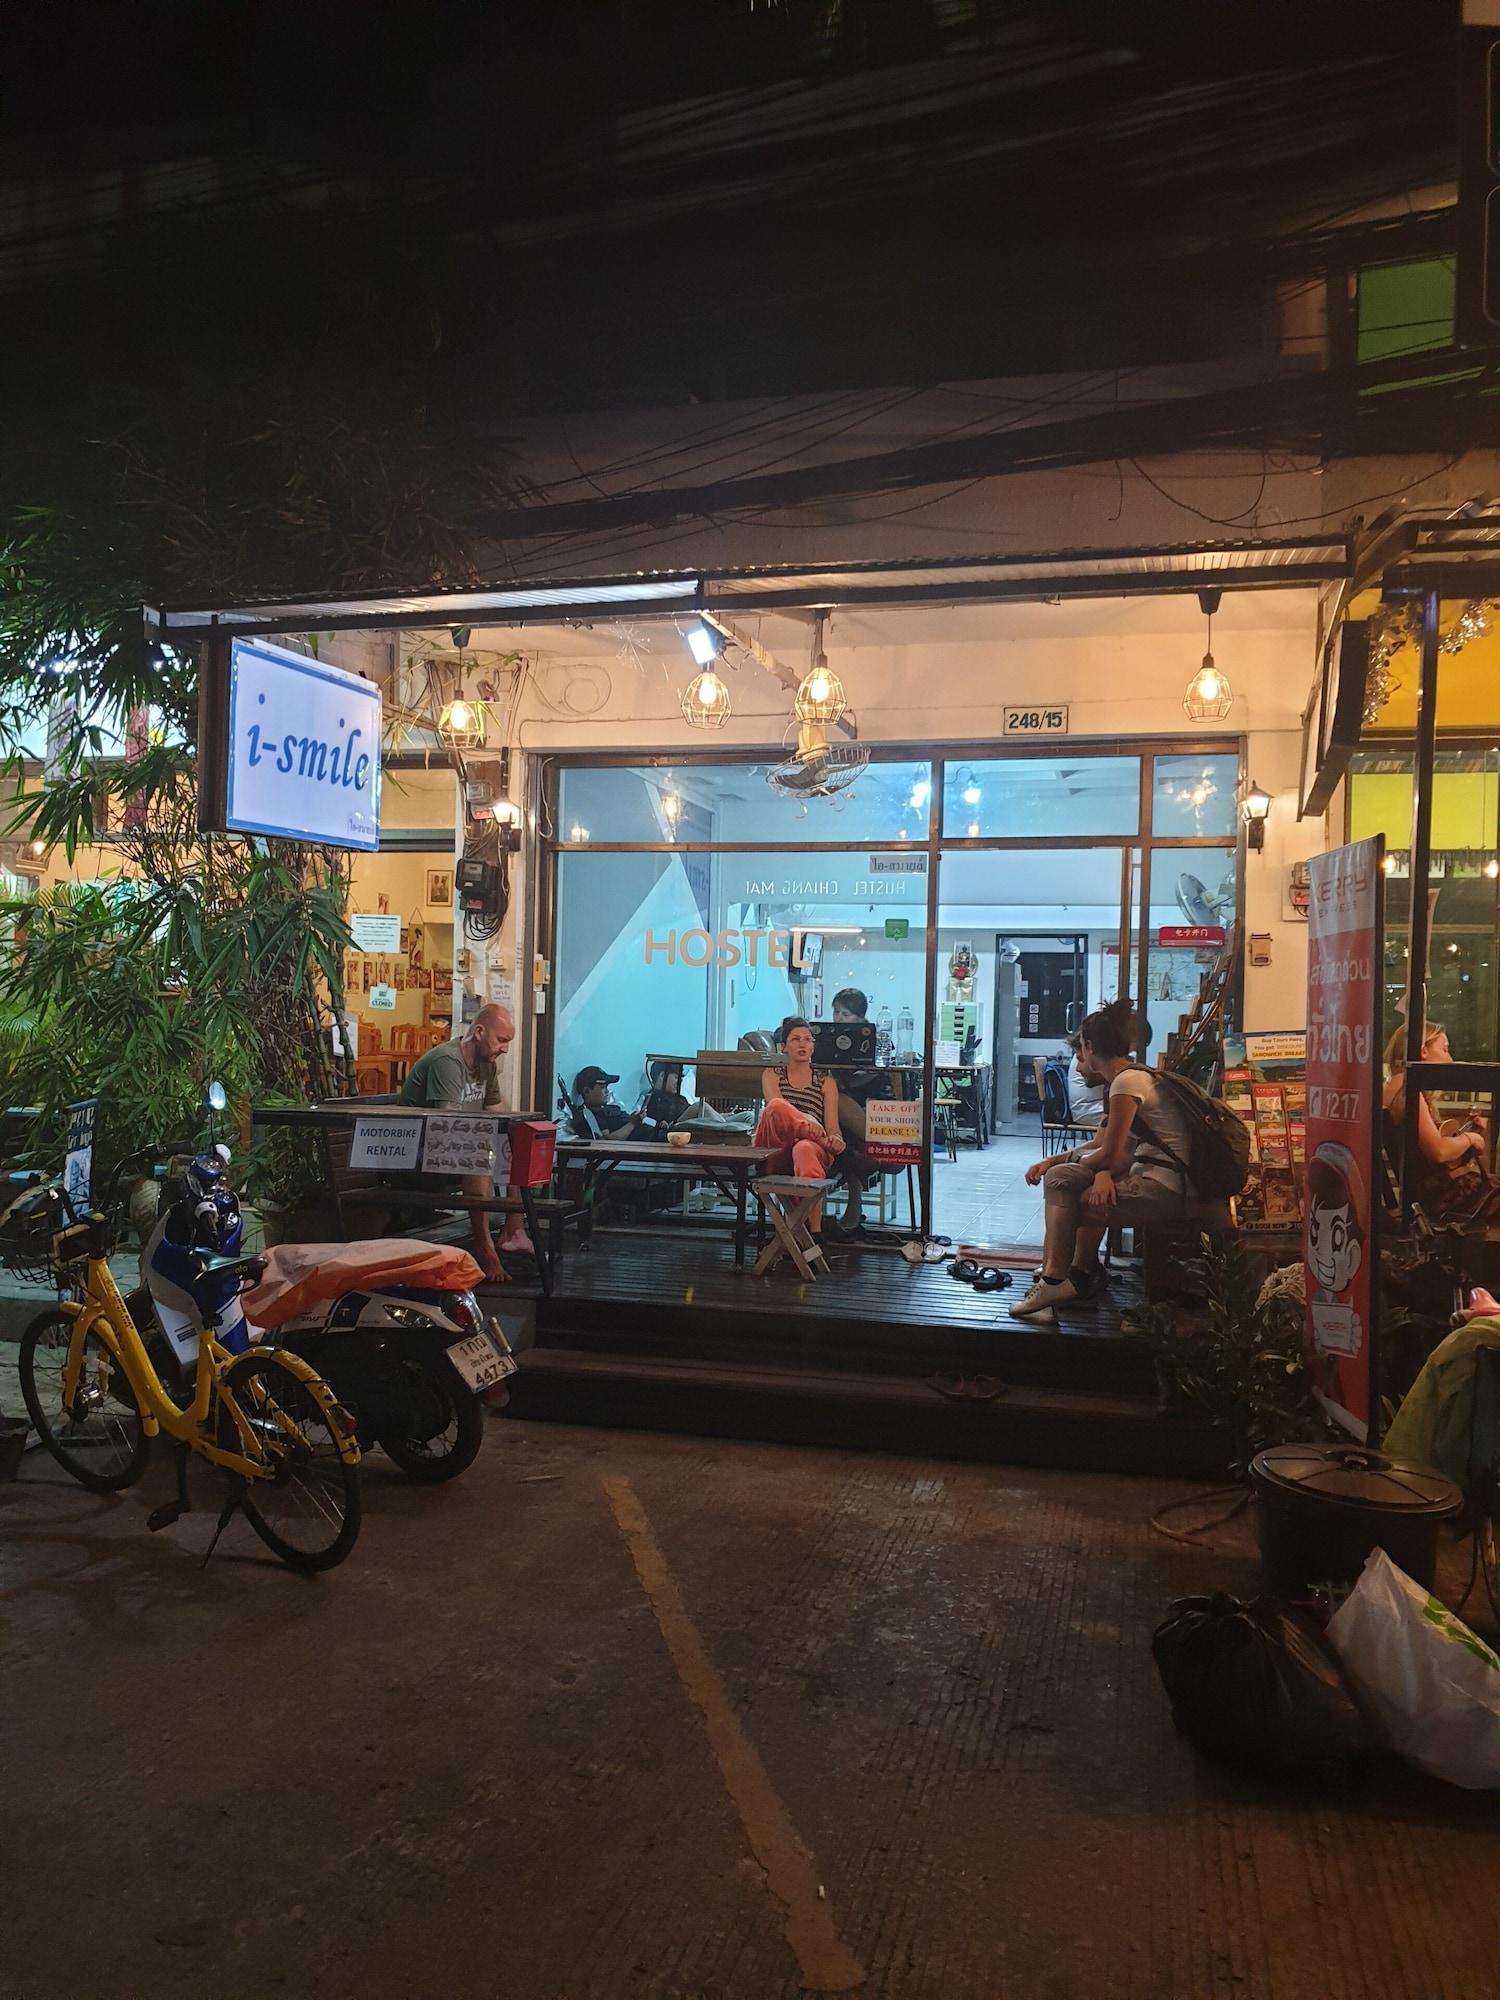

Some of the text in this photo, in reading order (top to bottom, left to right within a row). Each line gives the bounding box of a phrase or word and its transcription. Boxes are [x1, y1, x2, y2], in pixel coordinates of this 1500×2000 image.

[1008, 710, 1063, 730] 248/15
[247, 693, 369, 791] i-smile
[644, 927, 814, 969] HOSTEL
[872, 1104, 918, 1113] TAKE OFF
[1326, 1092, 1360, 1119] 1217
[869, 1116, 921, 1124] YOUR SHOES
[360, 1128, 417, 1138] MOTORBIKE
[366, 1145, 407, 1156] RENTAL
[475, 1361, 508, 1385] 4473
